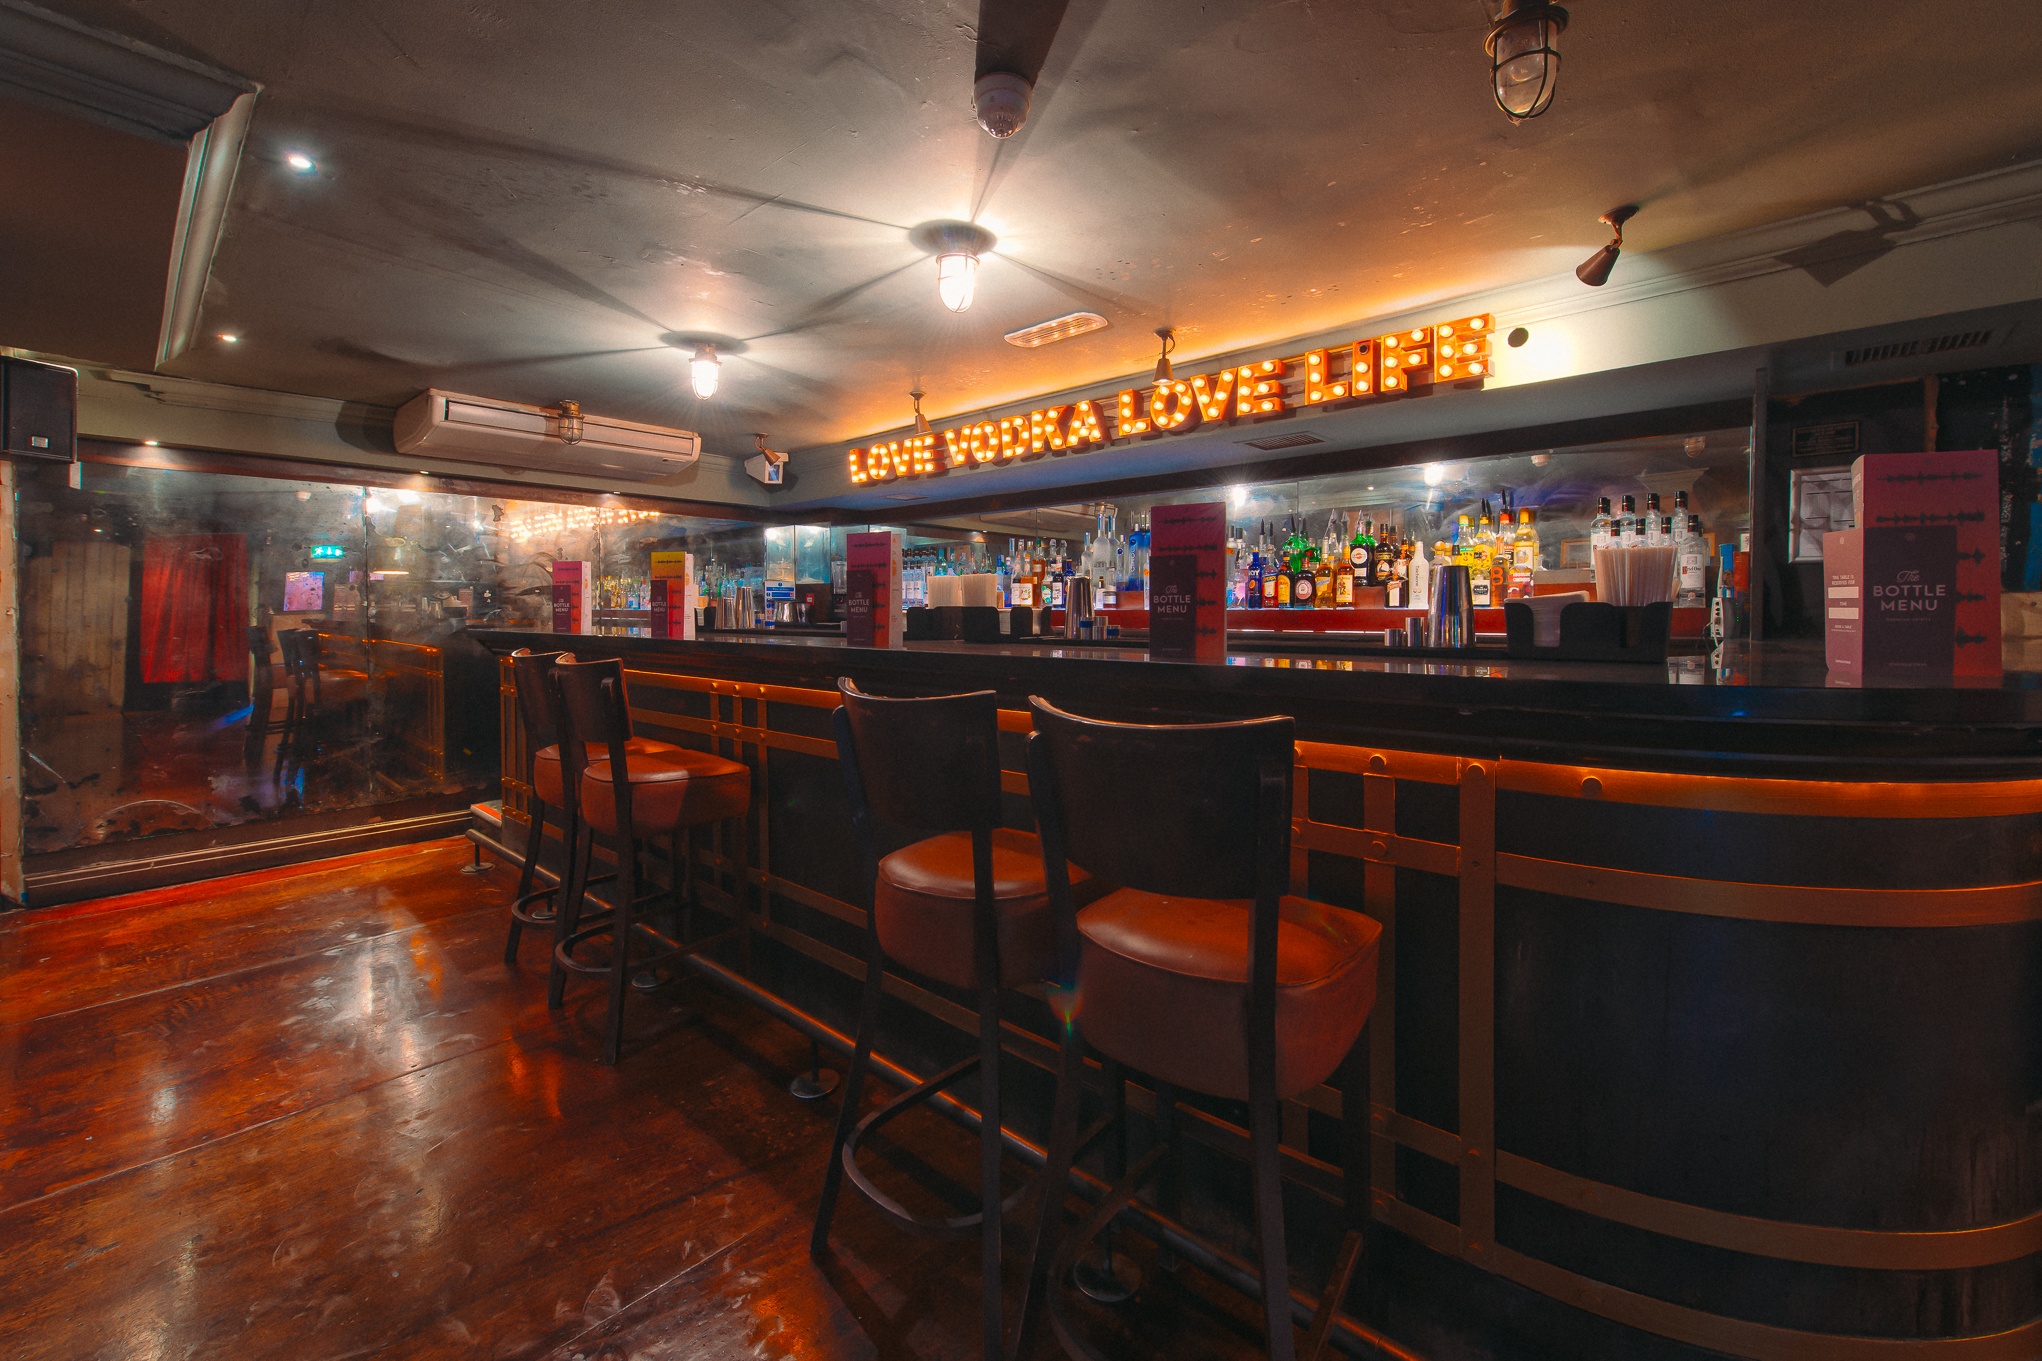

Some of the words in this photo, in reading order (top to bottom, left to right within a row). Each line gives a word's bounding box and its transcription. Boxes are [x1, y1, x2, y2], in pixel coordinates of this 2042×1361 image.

[849, 434, 946, 484] LOVE
[946, 399, 1103, 468] VODKA
[1118, 359, 1286, 437] LOVE
[1304, 313, 1495, 405] LIFE
[1897, 570, 1920, 583] The
[1873, 584, 1946, 597] BOTTLE
[1153, 595, 1191, 604] BOTTLE
[1881, 599, 1938, 611] MENU
[1157, 605, 1187, 613] MENU
